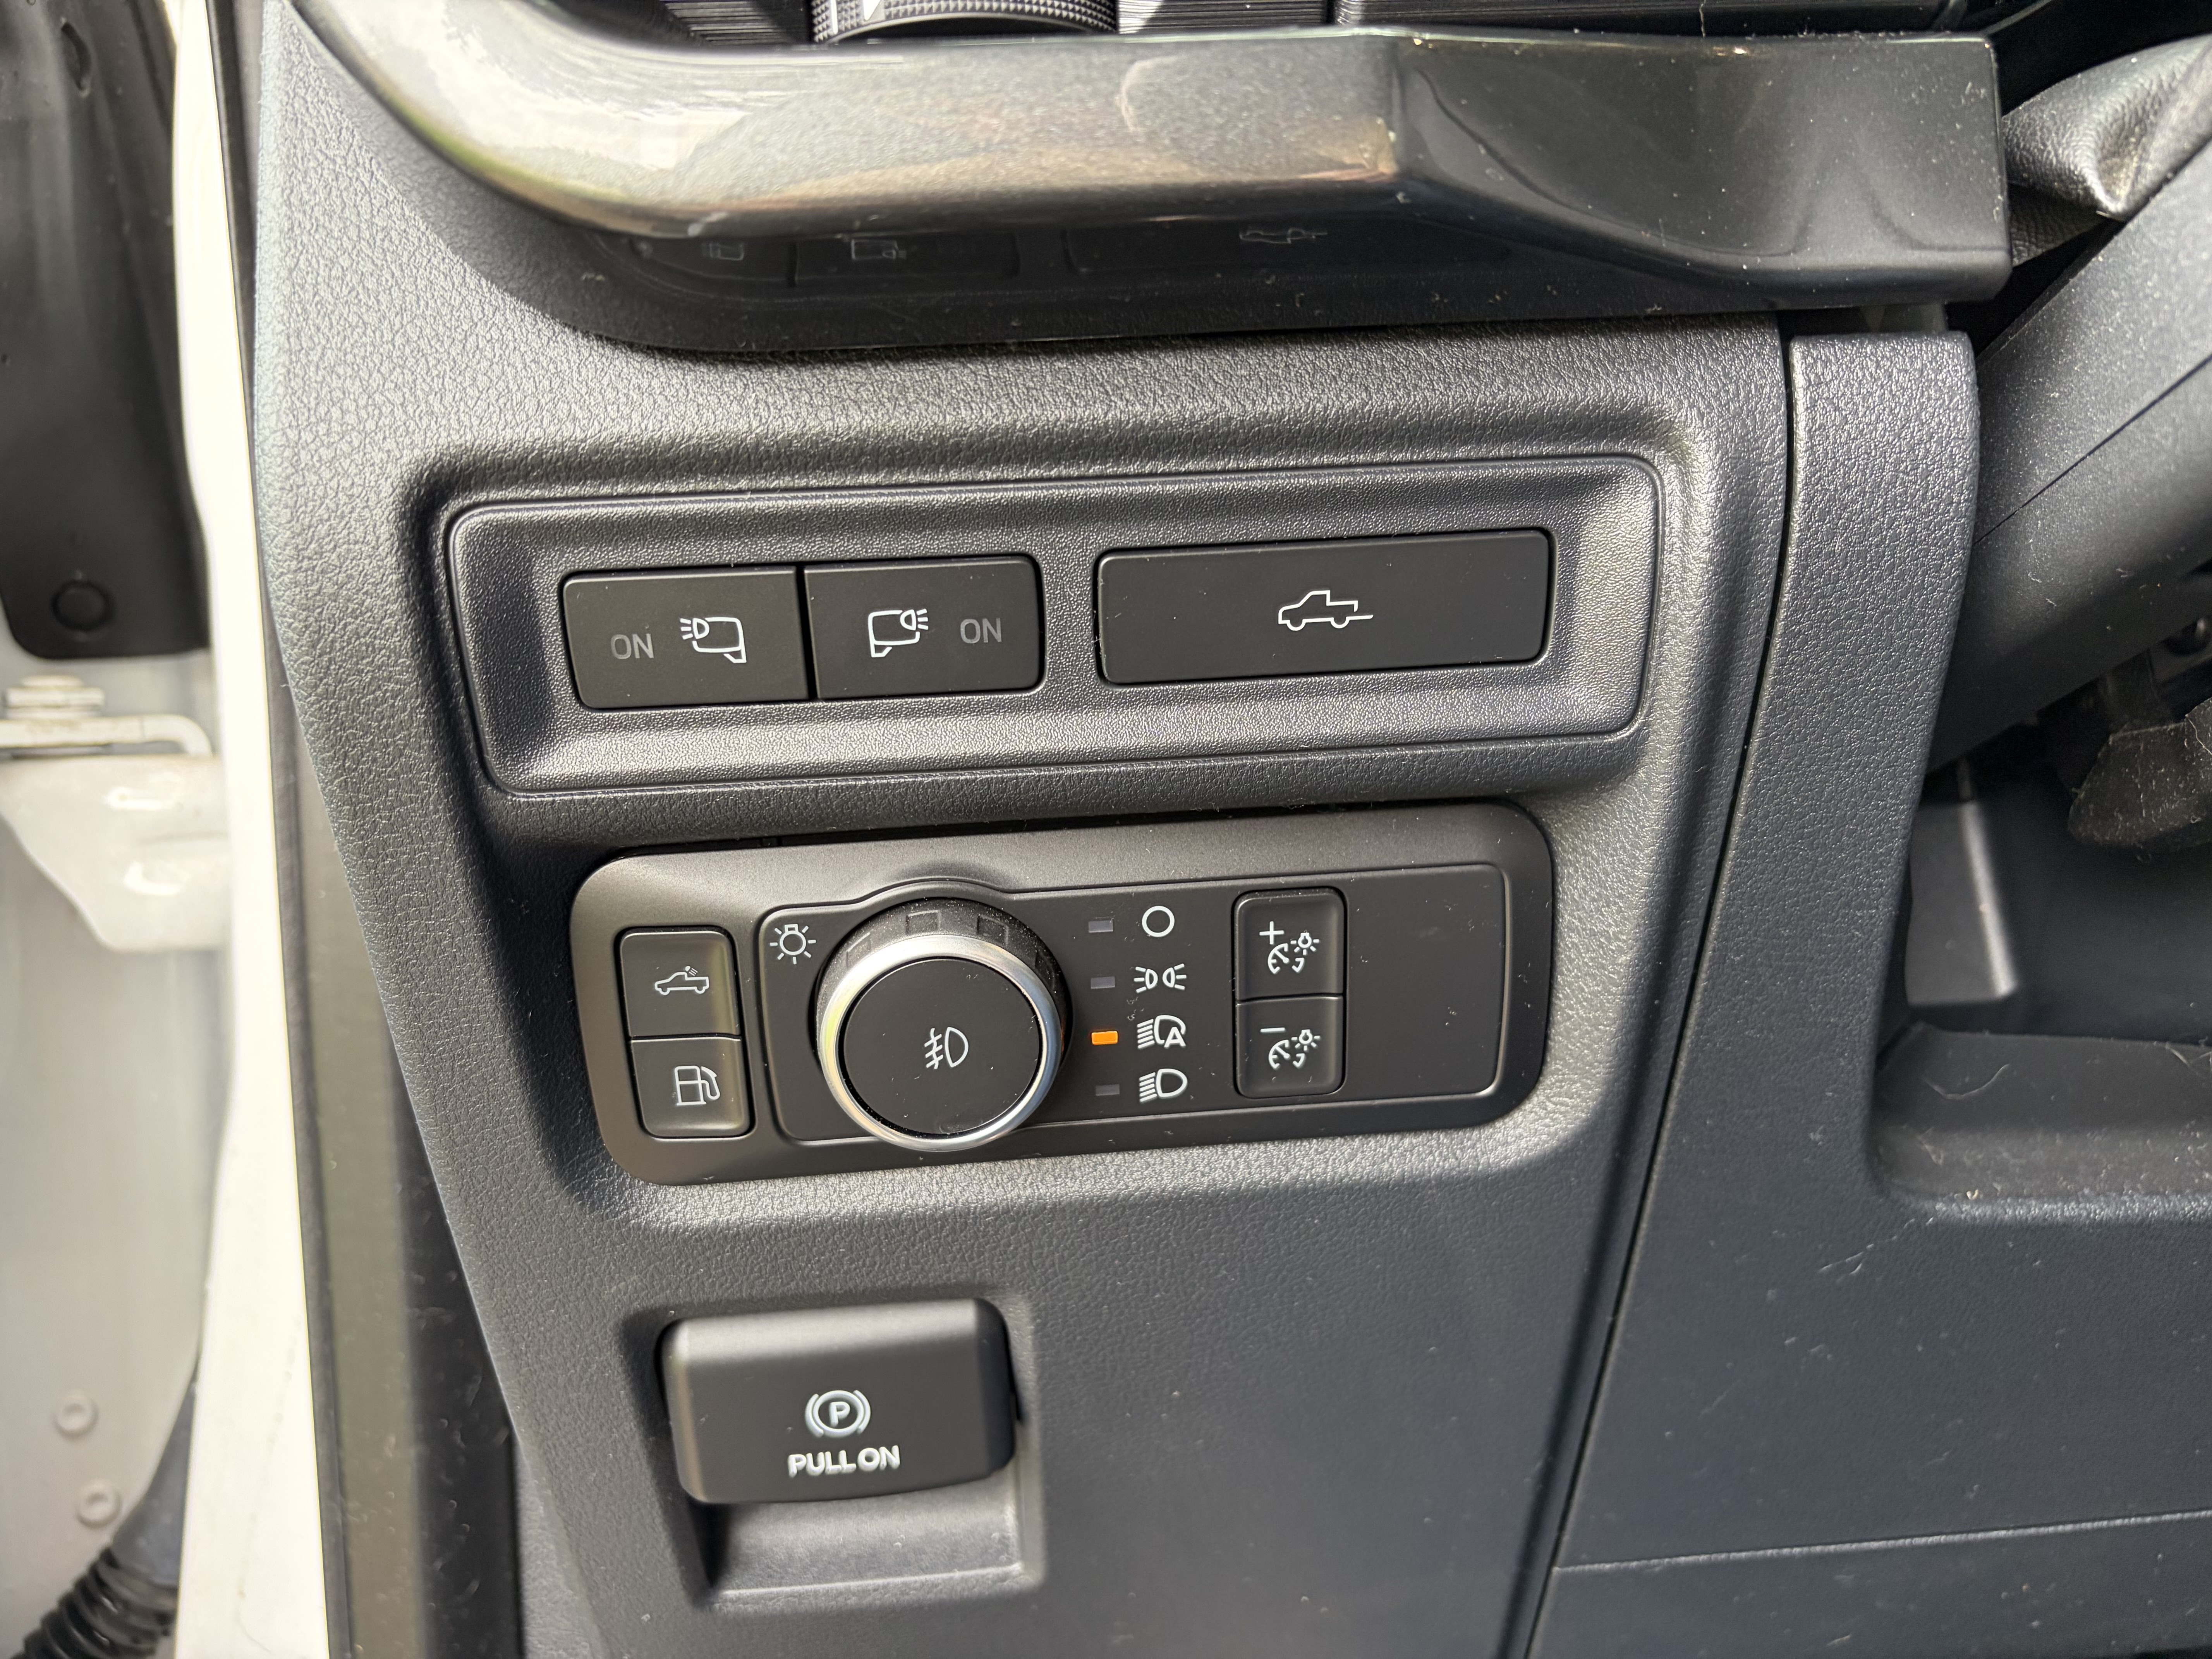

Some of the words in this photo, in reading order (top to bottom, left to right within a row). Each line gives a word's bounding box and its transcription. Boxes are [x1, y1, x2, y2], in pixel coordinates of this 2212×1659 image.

[960, 618, 1002, 644] ON
[611, 634, 654, 659] ON
[830, 1401, 850, 1425] P
[788, 1450, 857, 1477] PULL
[857, 1445, 900, 1471] ON
